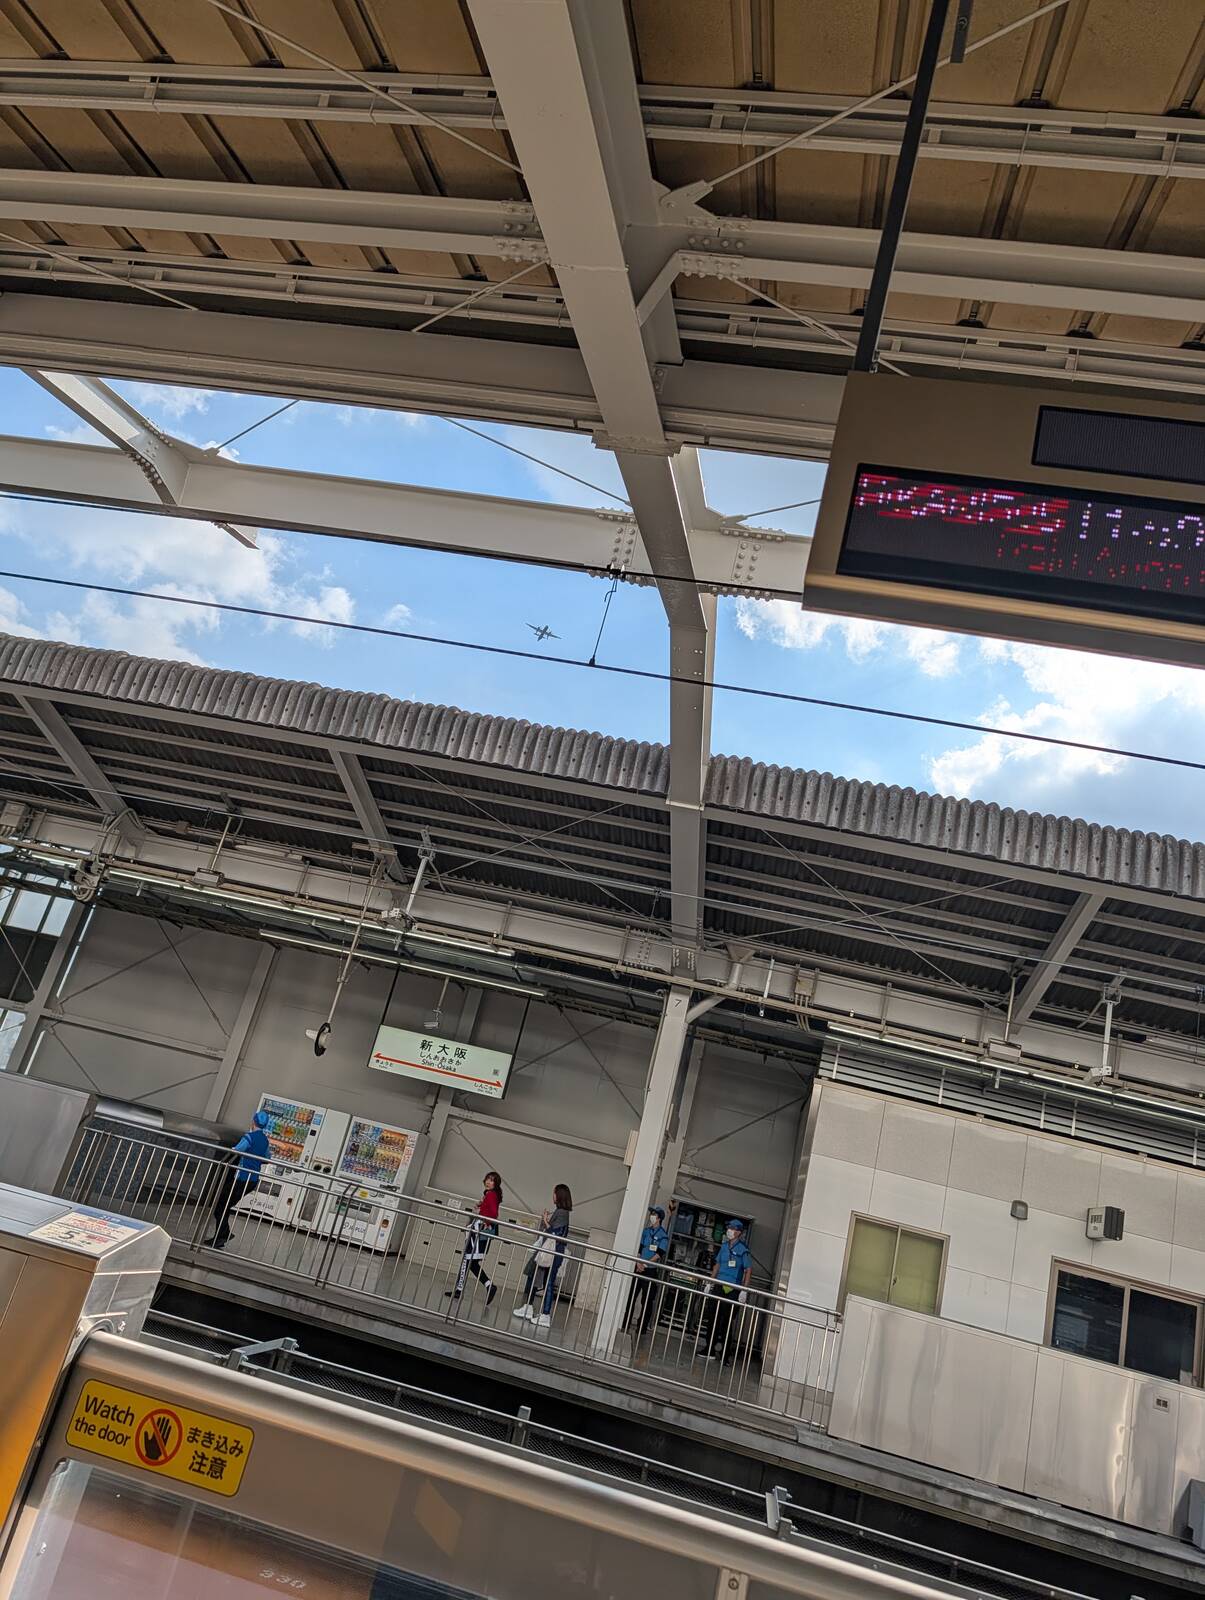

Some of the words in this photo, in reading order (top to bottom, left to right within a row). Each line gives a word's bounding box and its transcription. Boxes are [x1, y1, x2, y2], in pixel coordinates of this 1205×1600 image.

[419, 1039, 468, 1060] 新大阪
[419, 1051, 462, 1066] しんおおさか
[84, 1394, 135, 1427] Watch
[74, 1416, 97, 1436] the
[97, 1424, 132, 1447] door
[186, 1426, 244, 1458] まき込み
[188, 1450, 228, 1480] 注意
